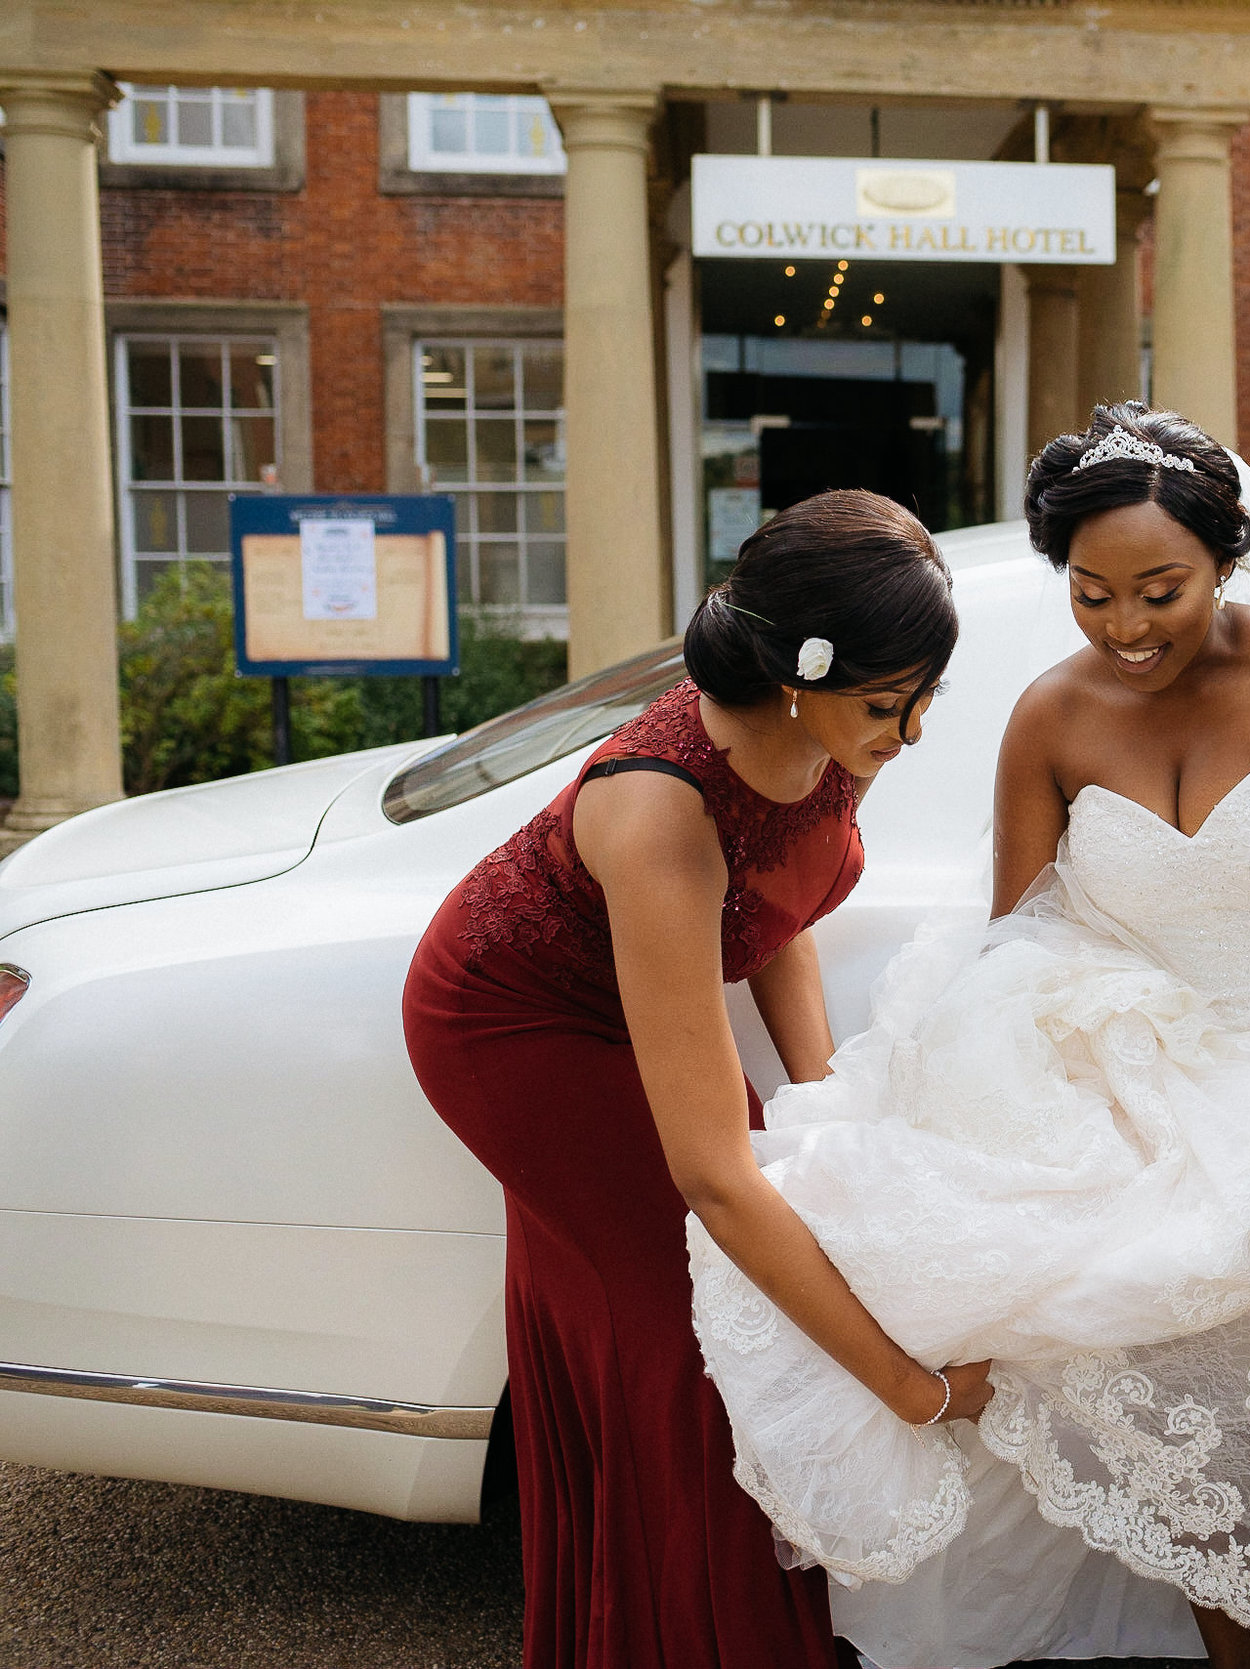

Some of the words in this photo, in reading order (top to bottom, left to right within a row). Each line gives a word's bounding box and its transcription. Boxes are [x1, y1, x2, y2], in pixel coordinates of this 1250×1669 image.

[716, 220, 875, 250] COLWICK
[888, 225, 976, 250] HALL
[986, 227, 1094, 255] HOTEL
